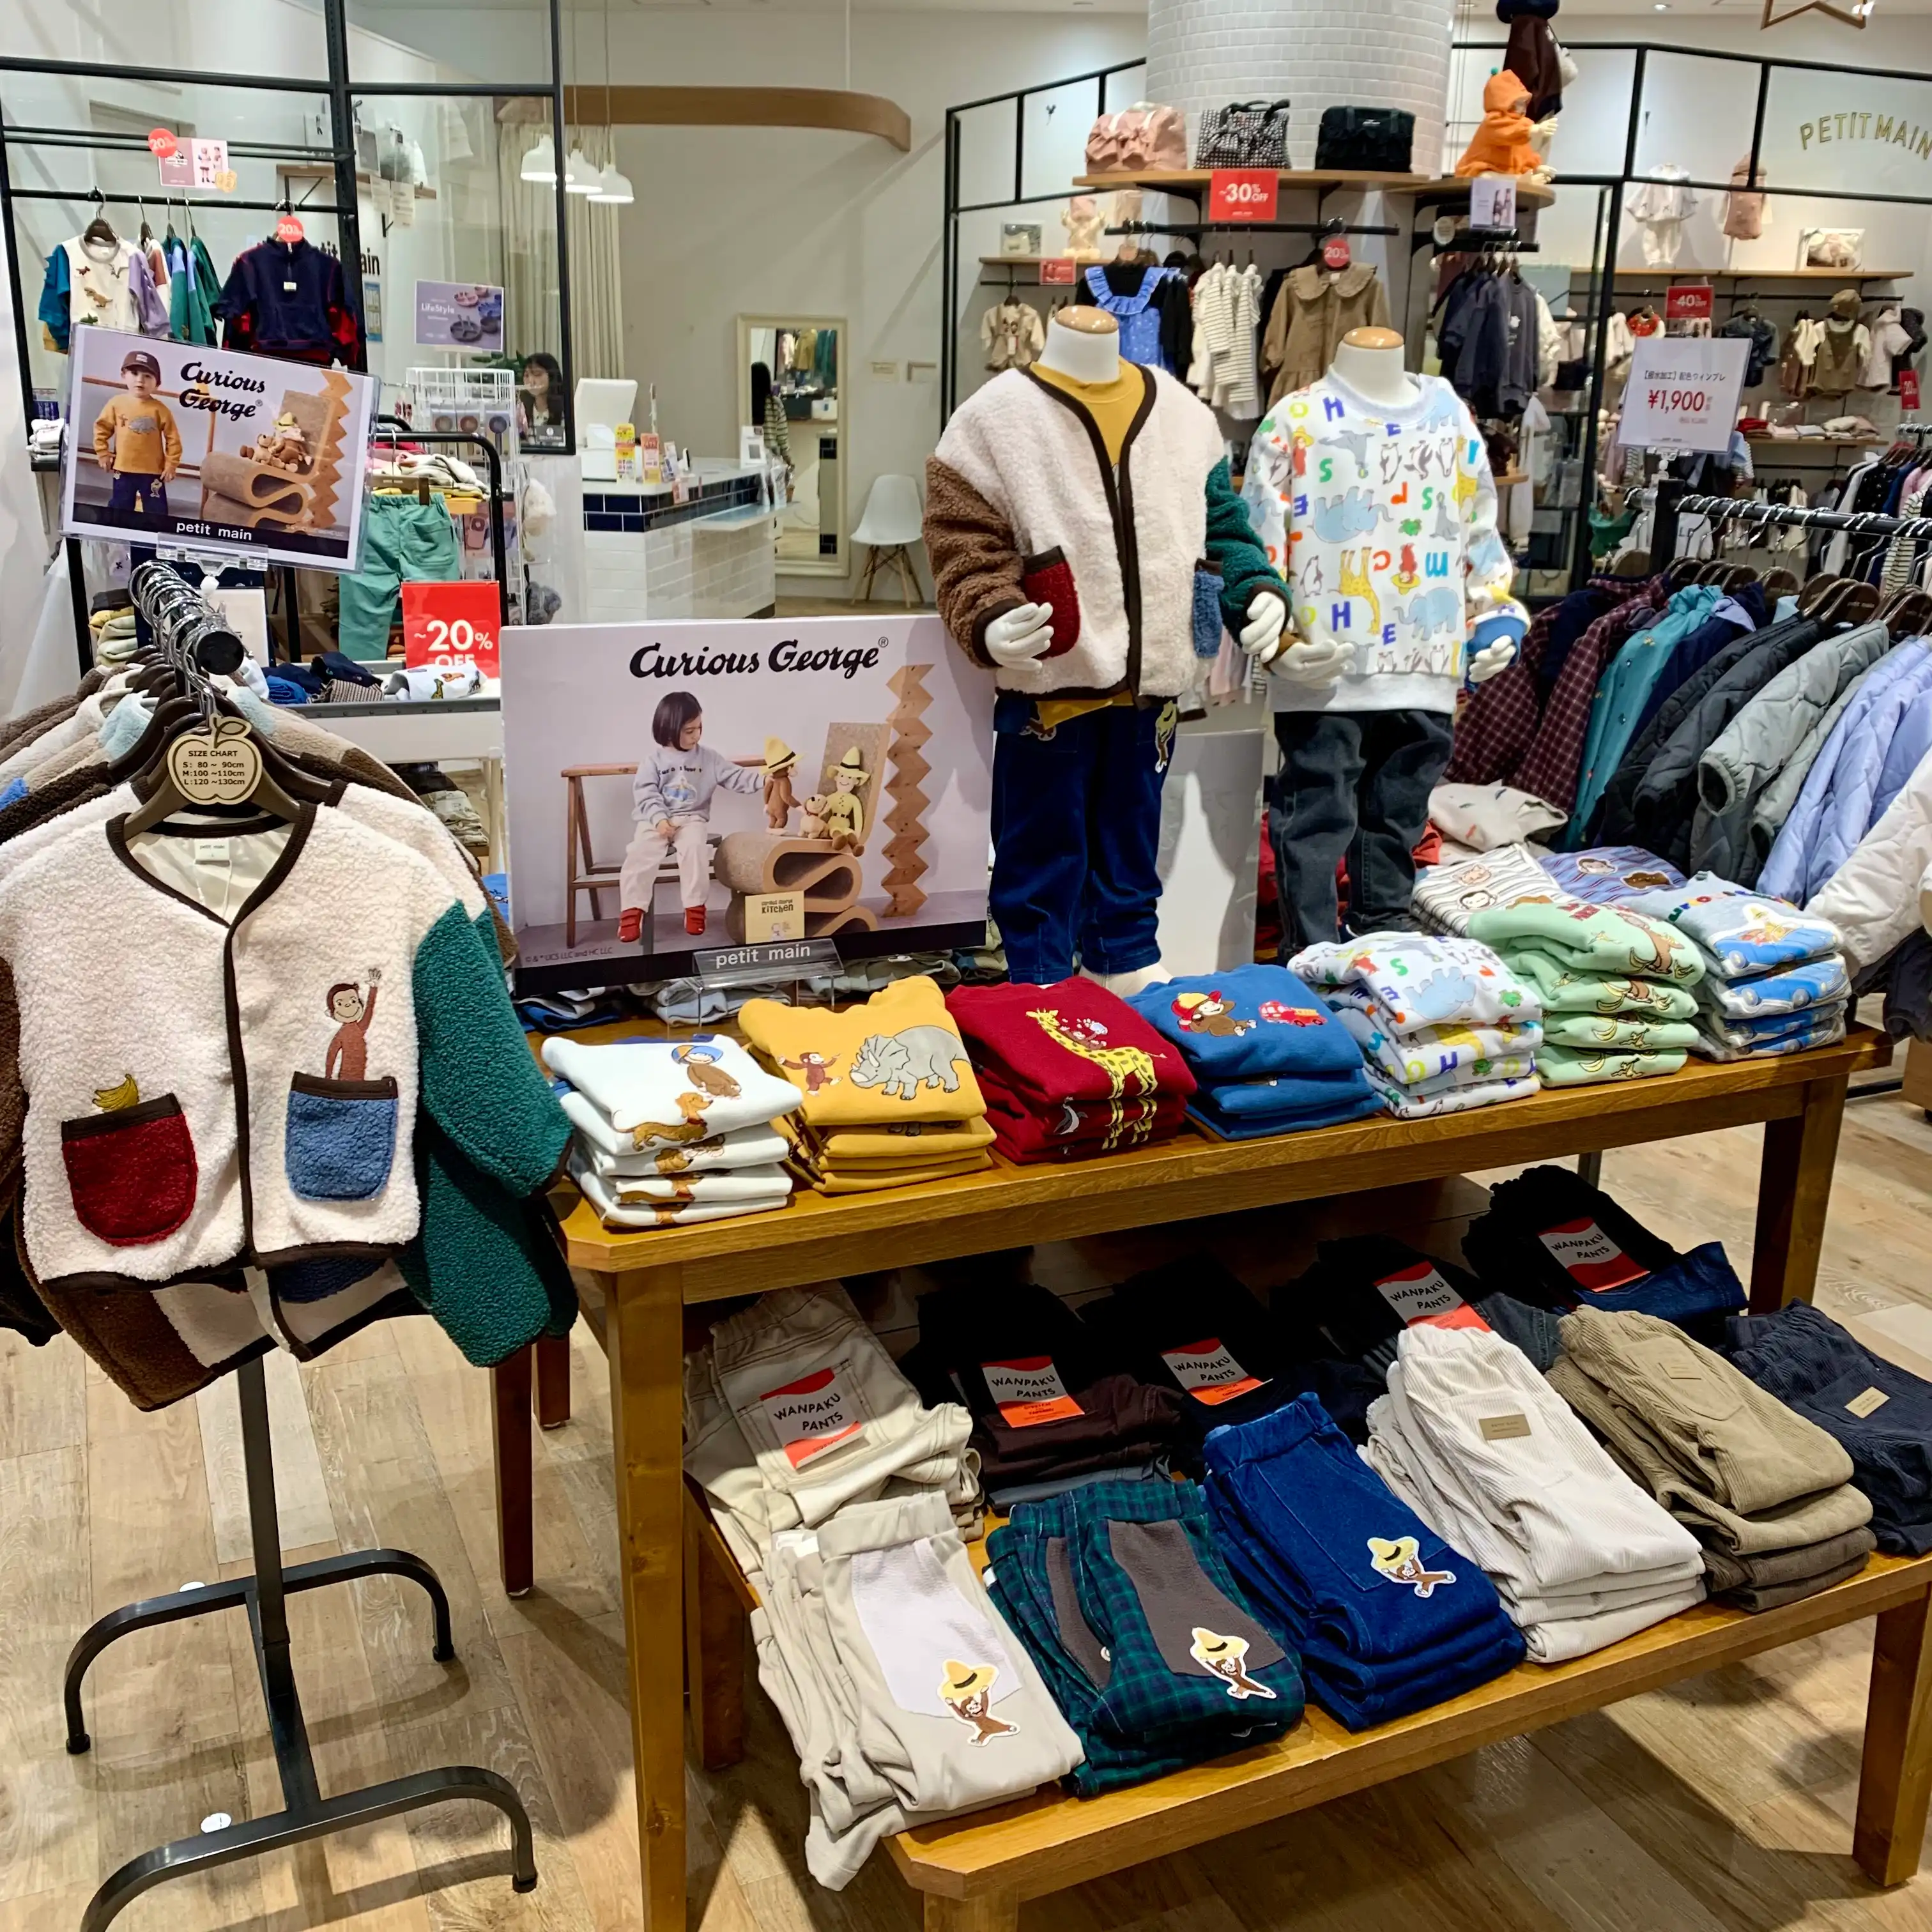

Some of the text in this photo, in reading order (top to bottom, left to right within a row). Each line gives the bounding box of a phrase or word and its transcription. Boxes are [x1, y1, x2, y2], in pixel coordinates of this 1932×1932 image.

[1800, 112, 1932, 160] PETIT MAIN
[180, 362, 265, 393] Curious
[1648, 389, 1705, 413] ¥1,900
[176, 523, 252, 541] petit main
[629, 642, 760, 678] Curious
[716, 944, 811, 969] petit main
[1551, 1234, 1604, 1251] WANPAKU
[1577, 1246, 1610, 1259] PANTS
[1390, 1280, 1445, 1302] WANPAKU
[1416, 1294, 1451, 1310] PANTS
[1174, 1356, 1230, 1372] WANPAKU
[992, 1375, 1055, 1386] WANPAKU
[1200, 1369, 1236, 1381] PANTS
[1016, 1388, 1055, 1397] PANTS
[773, 1393, 841, 1420] WANPAKU
[802, 1412, 843, 1431] PANTS
